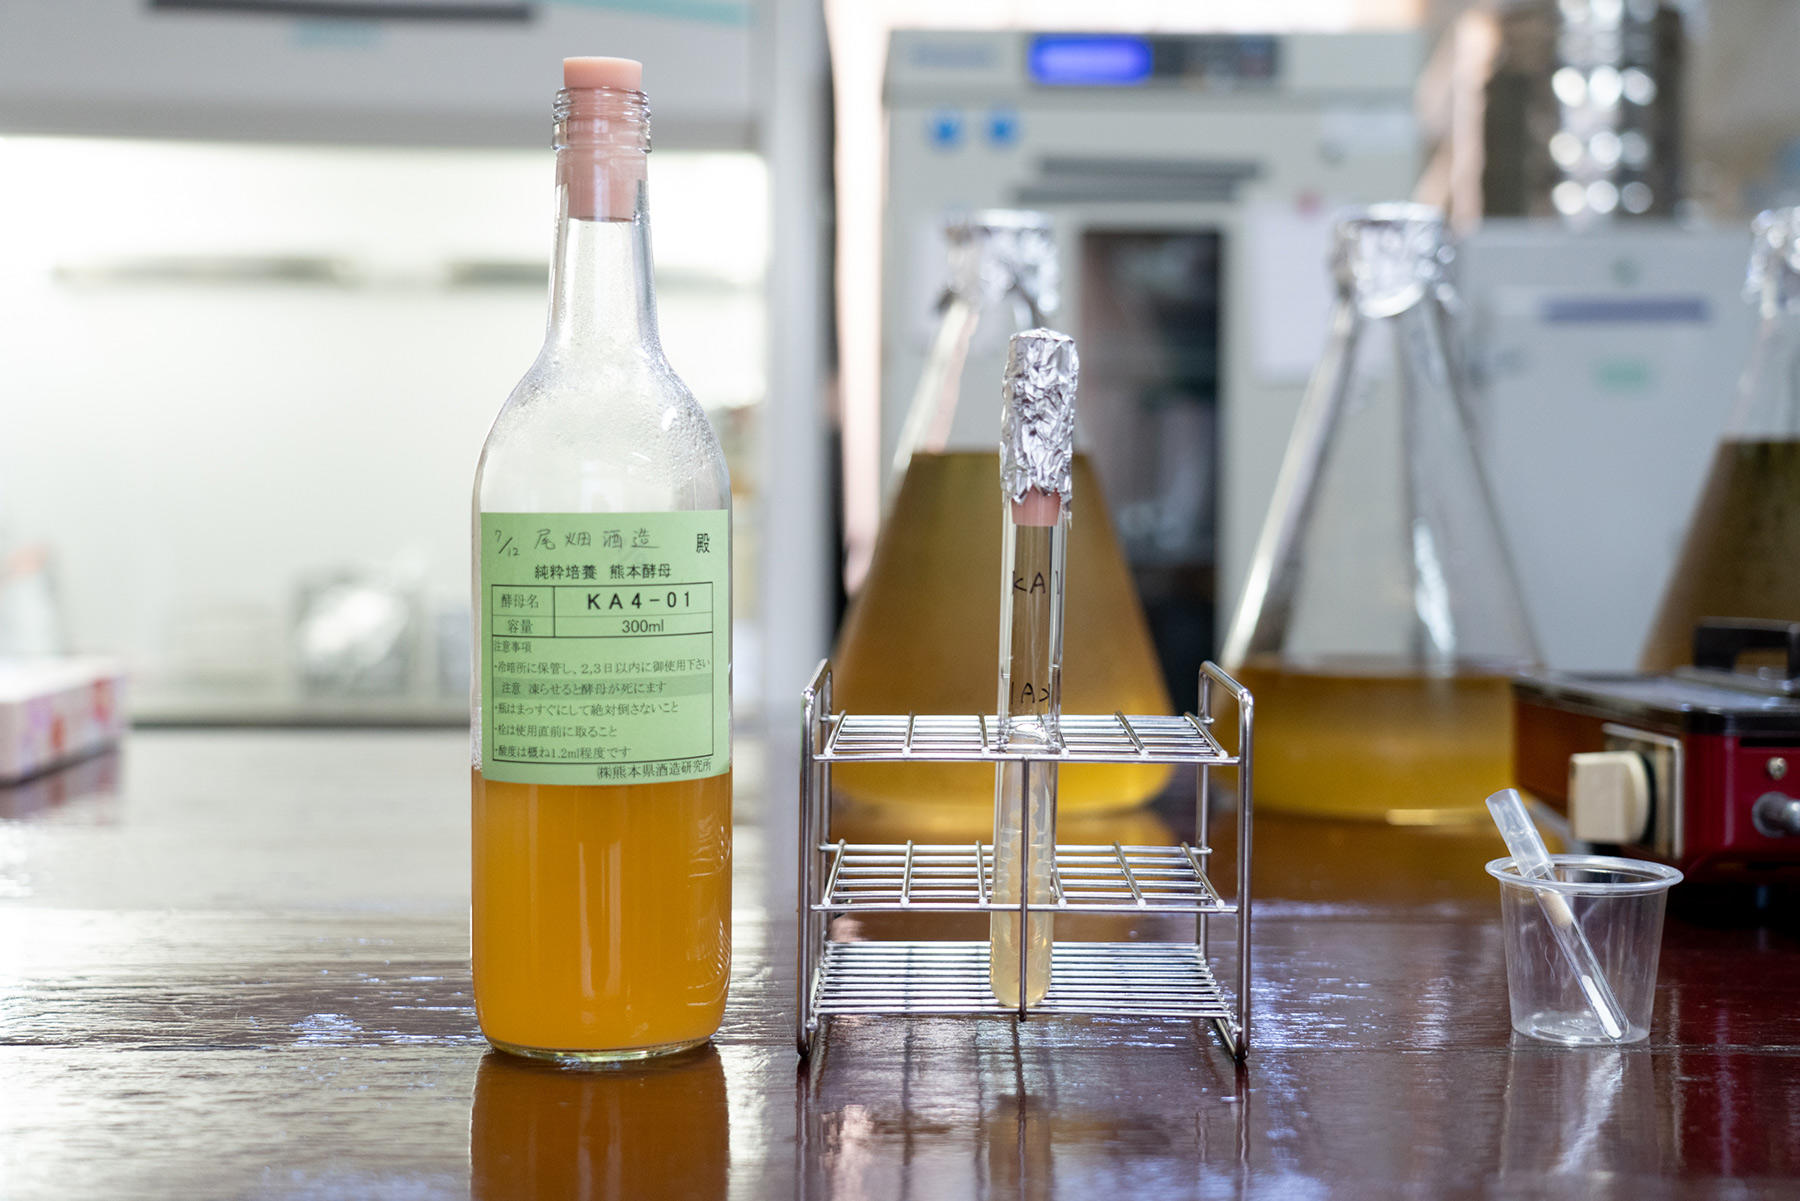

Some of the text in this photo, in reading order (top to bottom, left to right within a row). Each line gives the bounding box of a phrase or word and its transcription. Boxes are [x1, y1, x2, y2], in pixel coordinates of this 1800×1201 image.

[696, 533, 711, 554] 殿
[534, 563, 672, 581] 純粋培養 熊本酵母
[501, 593, 539, 610] 酵母名
[507, 618, 533, 634] 容量
[622, 618, 665, 634] 300ml
[494, 640, 532, 654] 注意事項
[502, 681, 521, 695] 注意
